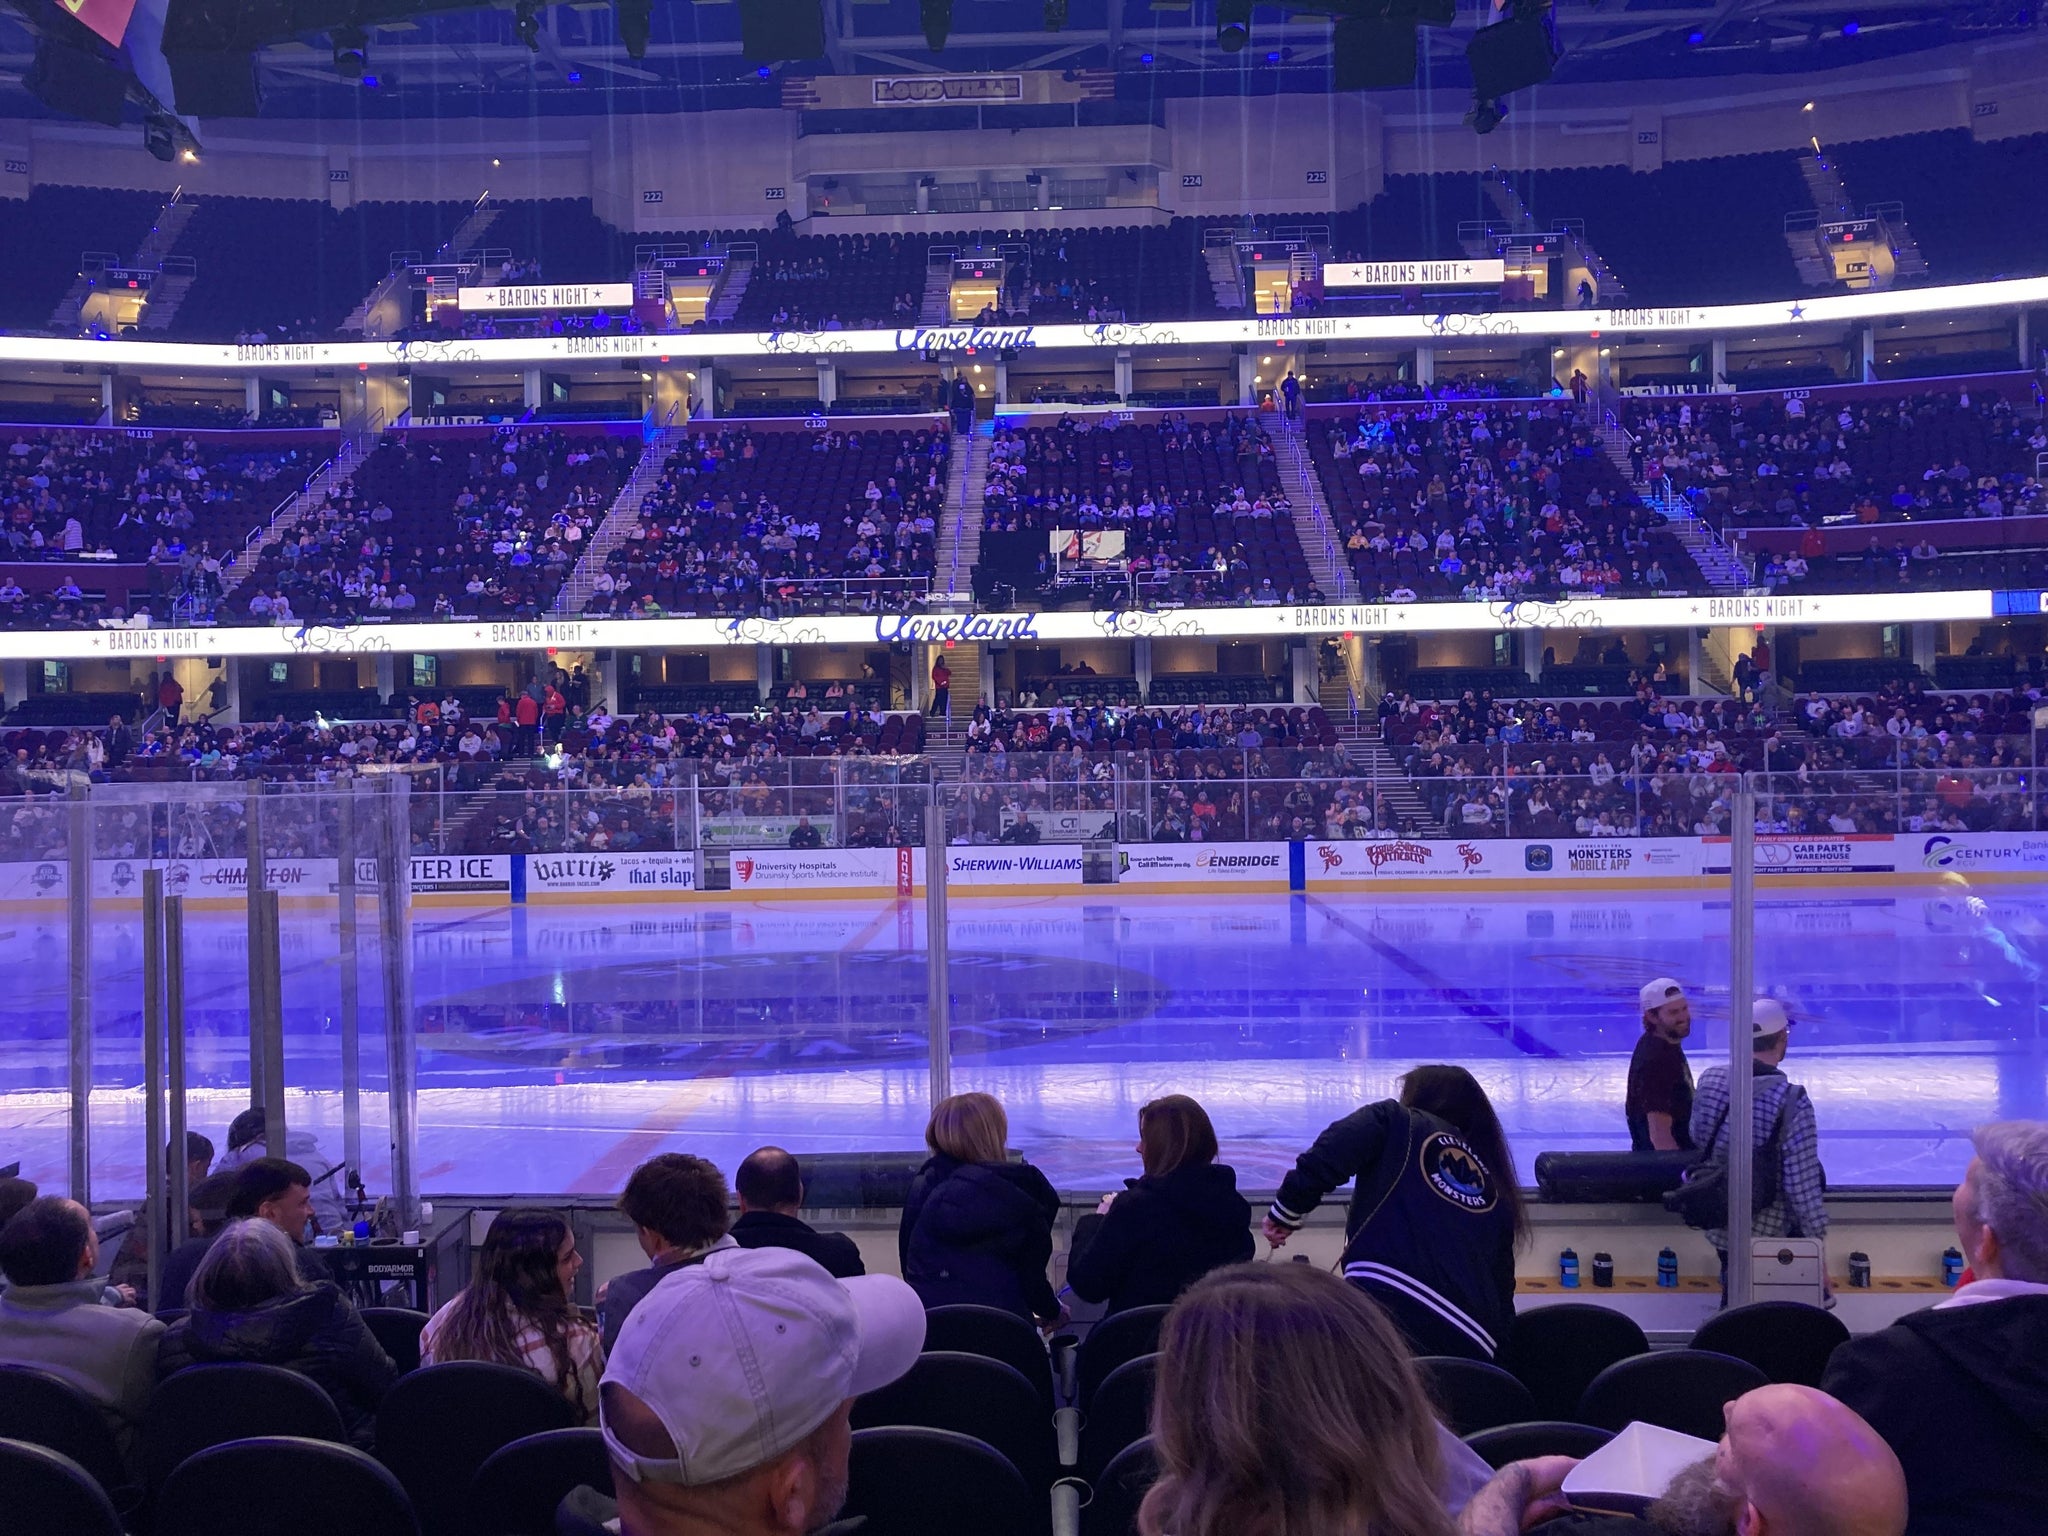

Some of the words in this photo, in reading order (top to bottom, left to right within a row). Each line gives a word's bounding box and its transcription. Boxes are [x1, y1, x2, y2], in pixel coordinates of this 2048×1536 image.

[876, 78, 1020, 101] LOUDVILLE
[6, 162, 27, 173] 220
[330, 171, 349, 181] 221
[1182, 175, 1203, 187] 224
[1306, 171, 1326, 183] 225
[644, 191, 662, 202] 222
[765, 187, 785, 199] 223
[1828, 224, 1844, 234] 226
[1852, 222, 1868, 232] 227
[1240, 244, 1254, 252] 224
[1285, 243, 1298, 251] 225
[413, 267, 427, 275] 221
[960, 262, 975, 270] 223
[981, 261, 995, 269] 224
[113, 271, 128, 279] 220
[1365, 264, 1415, 283] BARONS
[1421, 262, 1459, 281] NIGHT
[499, 288, 546, 306] BARONS
[553, 287, 588, 305] NIGHT
[1610, 309, 1653, 327] BARONS
[1659, 308, 1691, 325] NIGHT
[1257, 319, 1300, 336] BARONS
[1305, 318, 1338, 335] NIGHT
[895, 325, 1036, 351] Cleveland
[567, 337, 608, 354] BARONS
[614, 336, 645, 353] NIGHT
[237, 345, 279, 362] BARONS
[285, 345, 315, 361] NIGHT
[1793, 390, 1810, 398] 123
[1432, 403, 1448, 411] 122
[1119, 412, 1134, 421] 121
[804, 420, 811, 428] C
[812, 420, 828, 428] 120
[127, 430, 135, 438] M
[136, 430, 154, 439] 118
[668, 610, 697, 618] Huntington
[1709, 599, 1760, 619] BARONS
[1766, 598, 1804, 618] NIGHT
[363, 615, 391, 623] Huntington
[450, 614, 479, 622] Huntington
[1295, 607, 1345, 627] BARONS
[1351, 606, 1389, 626] NIGHT
[492, 623, 541, 643] BARONS
[547, 623, 582, 642] NIGHT
[875, 612, 1038, 642] Cleveland
[109, 632, 157, 650] BARONS
[163, 631, 199, 649] NIGHT
[1793, 844, 1815, 852] CAR
[1816, 843, 1852, 852] PARTS
[1955, 848, 2022, 859] CENTURY
[1568, 848, 1632, 860] MONSTERS
[2023, 853, 2046, 862] Live
[649, 857, 673, 866] tequila
[755, 861, 798, 872] University
[799, 861, 837, 871] Hospitals
[952, 856, 1083, 872] SHERWIN-WILLIAMS
[1209, 855, 1280, 867] ENBRIDGE
[1570, 859, 1607, 871] MOBILE
[1610, 858, 1630, 871] APP
[459, 858, 493, 879] ICE
[629, 867, 657, 884] that
[755, 871, 790, 881] Drusinsky
[791, 870, 815, 881] Sports
[816, 870, 849, 879] Medicine
[1430, 1172, 1487, 1207] MONSTERS
[368, 1264, 415, 1273] BODYARMOR
